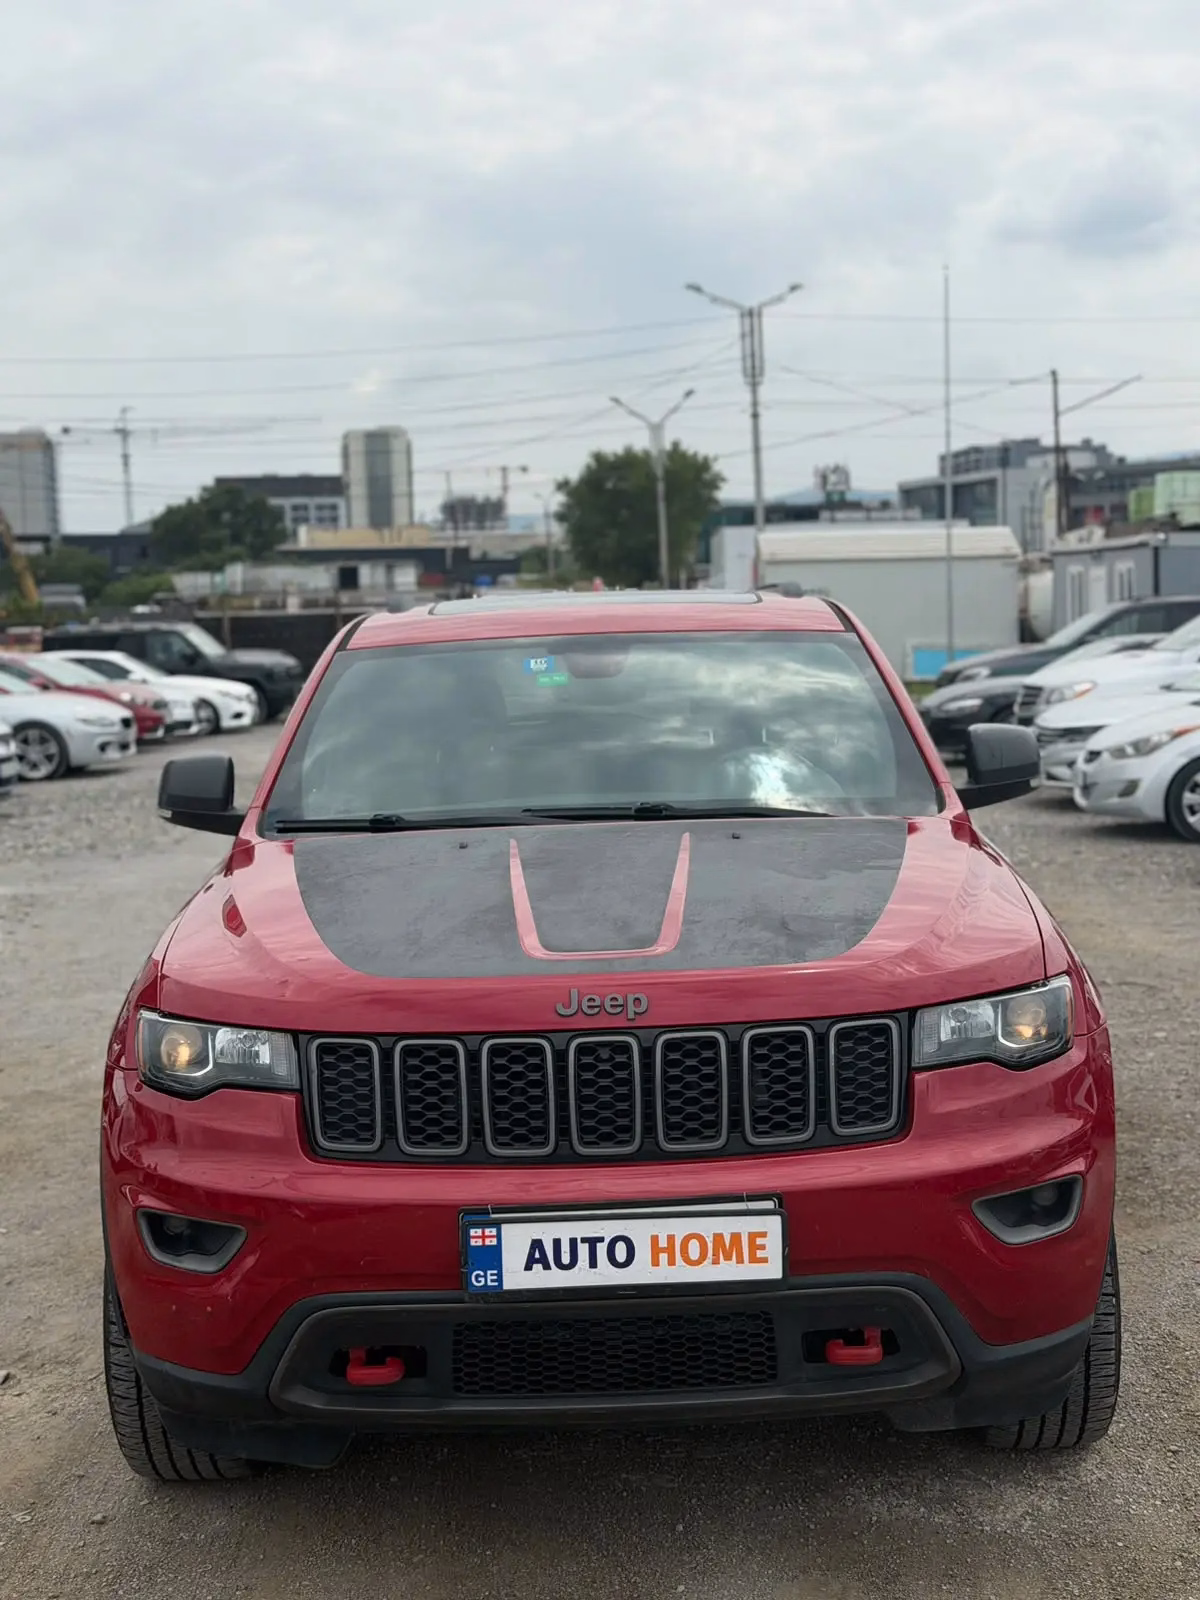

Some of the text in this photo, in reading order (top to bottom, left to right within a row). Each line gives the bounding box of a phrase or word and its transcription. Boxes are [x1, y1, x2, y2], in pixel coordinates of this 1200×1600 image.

[556, 988, 648, 1020] Jeep
[524, 1231, 769, 1272] AUTO HOME
[471, 1270, 498, 1286] GE
